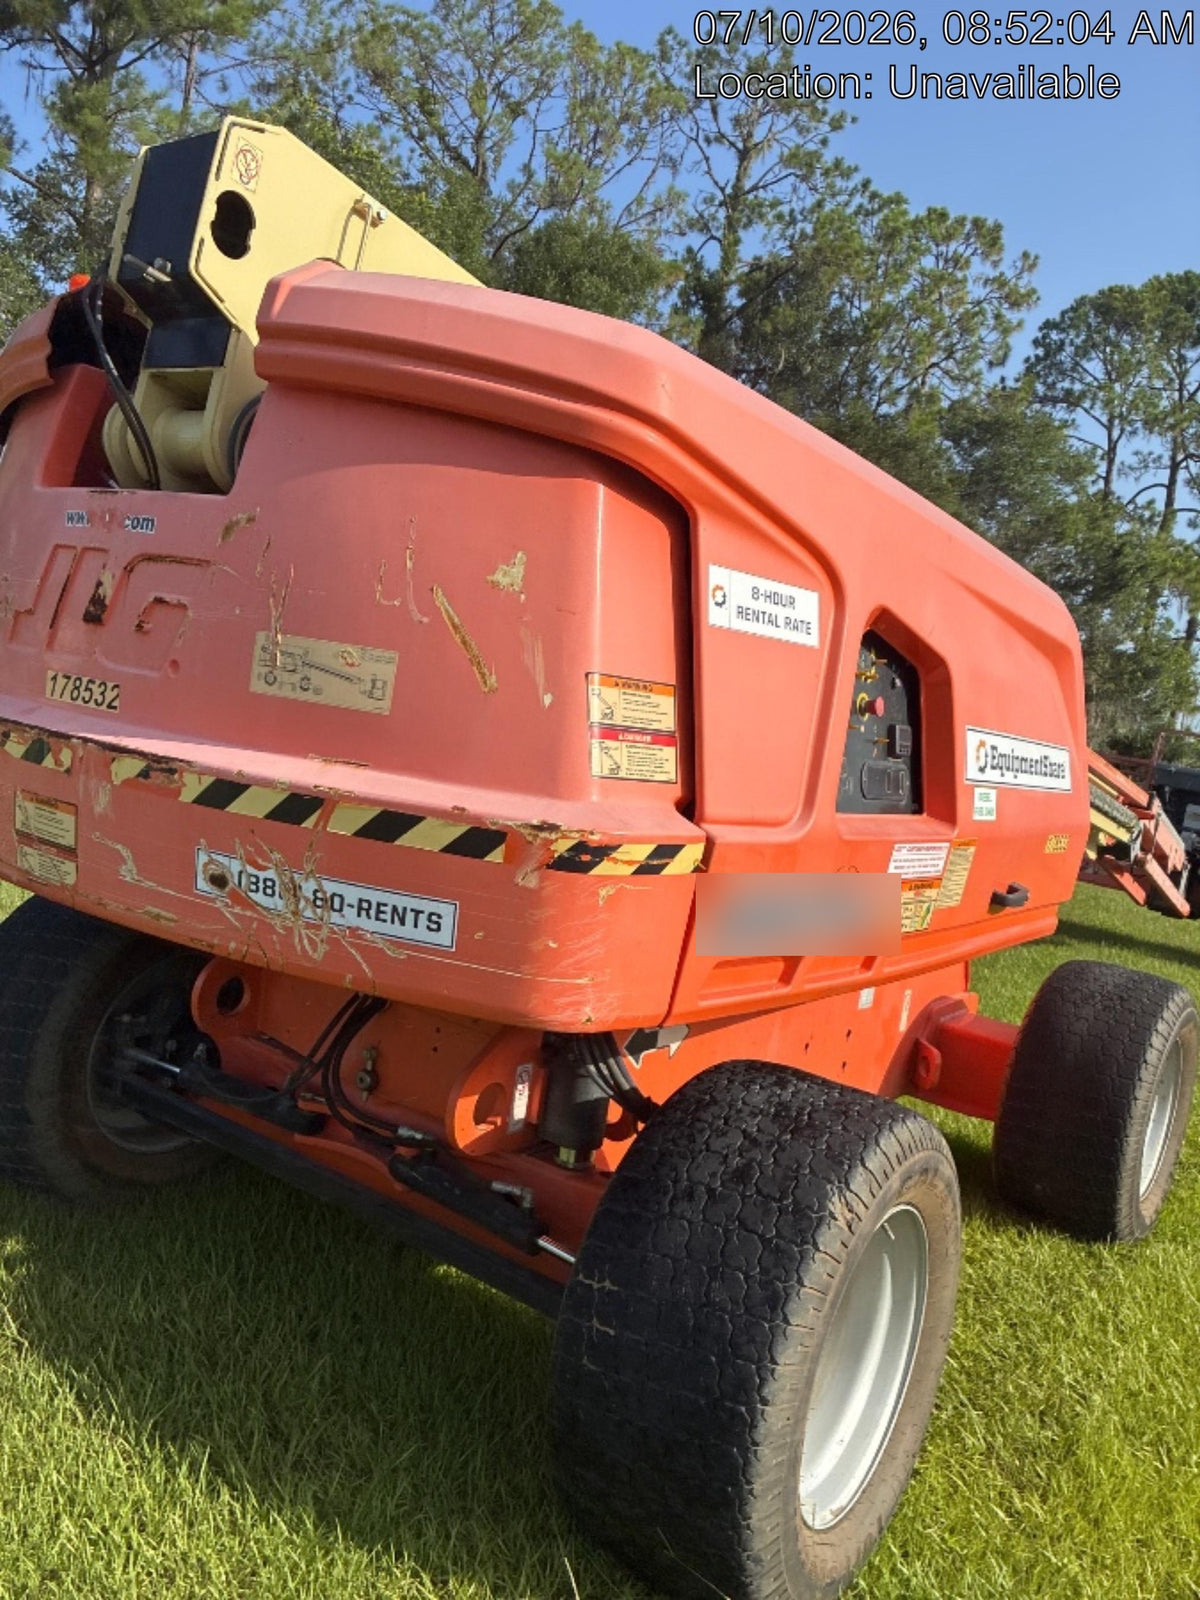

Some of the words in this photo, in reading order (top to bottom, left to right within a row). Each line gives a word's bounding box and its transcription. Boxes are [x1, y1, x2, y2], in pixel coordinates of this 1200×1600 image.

[751, 586, 796, 610] 8-HOUR
[736, 605, 781, 628] RENTAL
[784, 616, 812, 636] RATE
[50, 672, 120, 710] 178532
